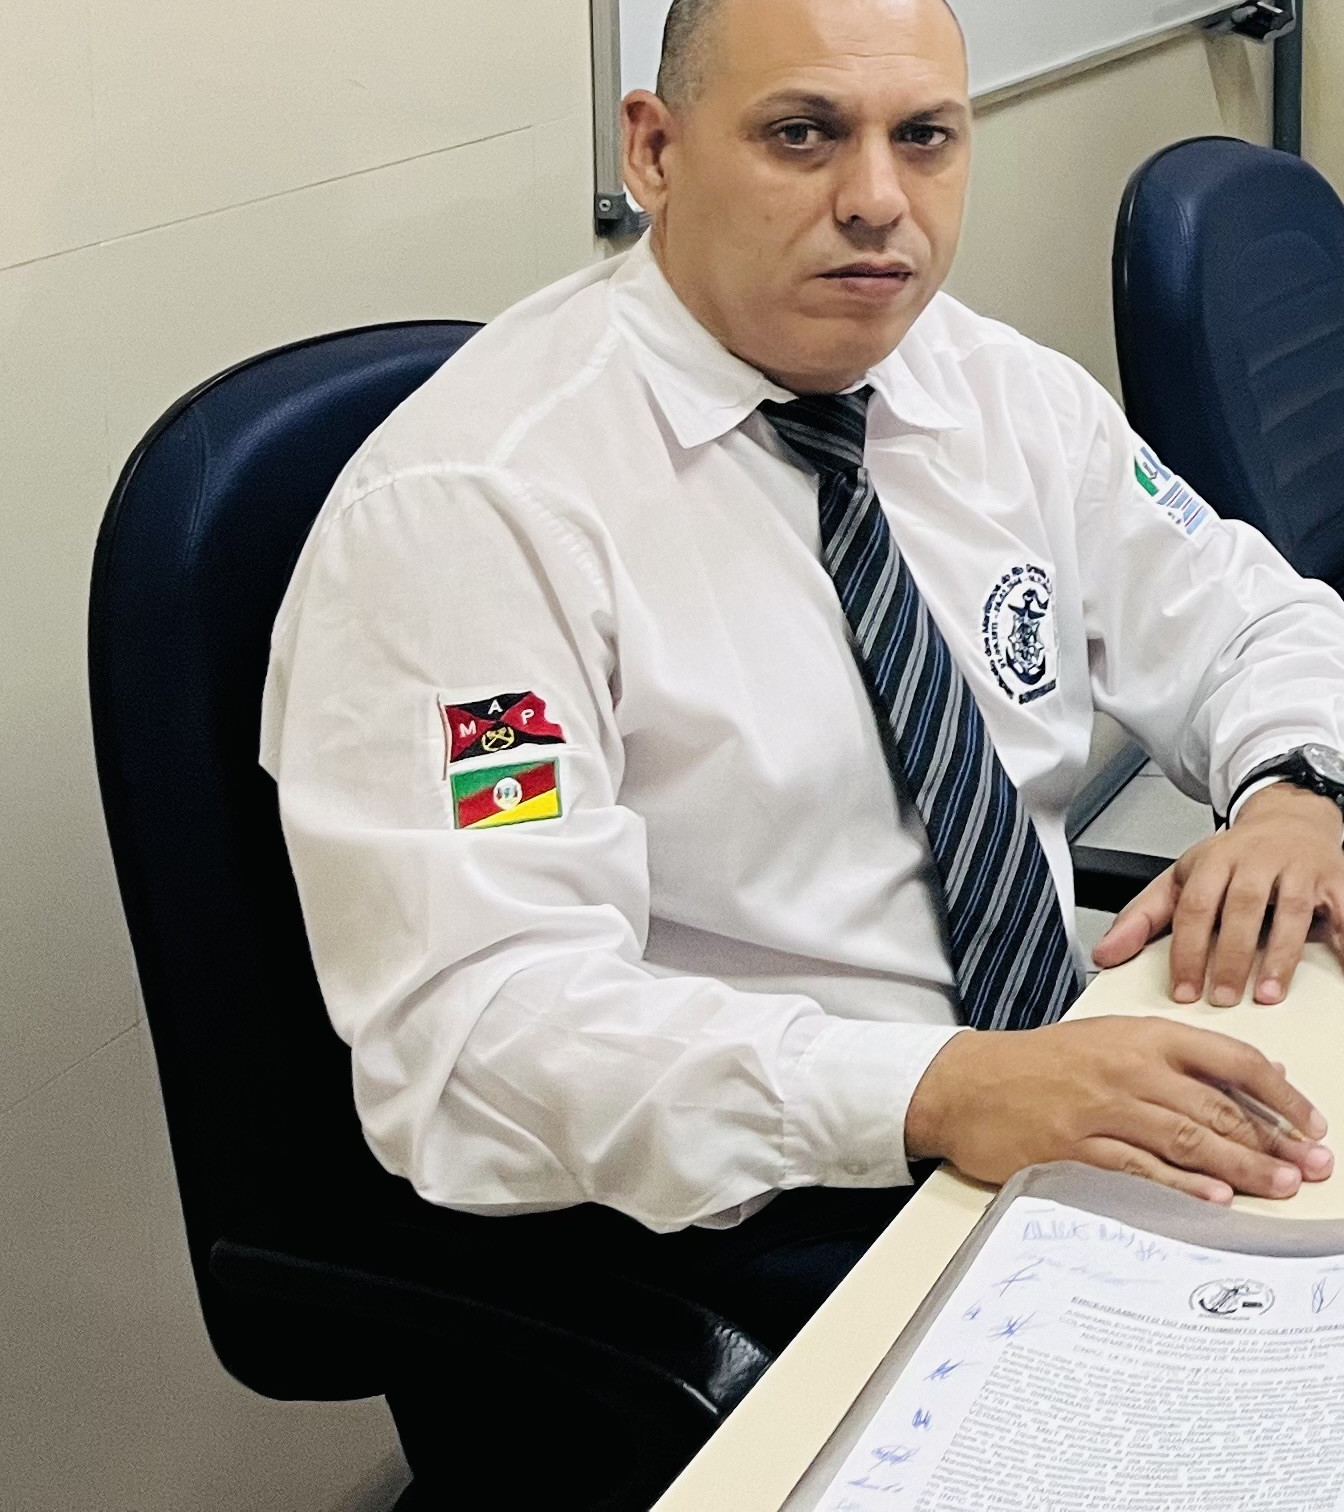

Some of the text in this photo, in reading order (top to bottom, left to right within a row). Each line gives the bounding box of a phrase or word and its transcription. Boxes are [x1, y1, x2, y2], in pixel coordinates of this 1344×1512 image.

[488, 699, 503, 715] A
[520, 708, 535, 726] P
[459, 720, 477, 738] M
